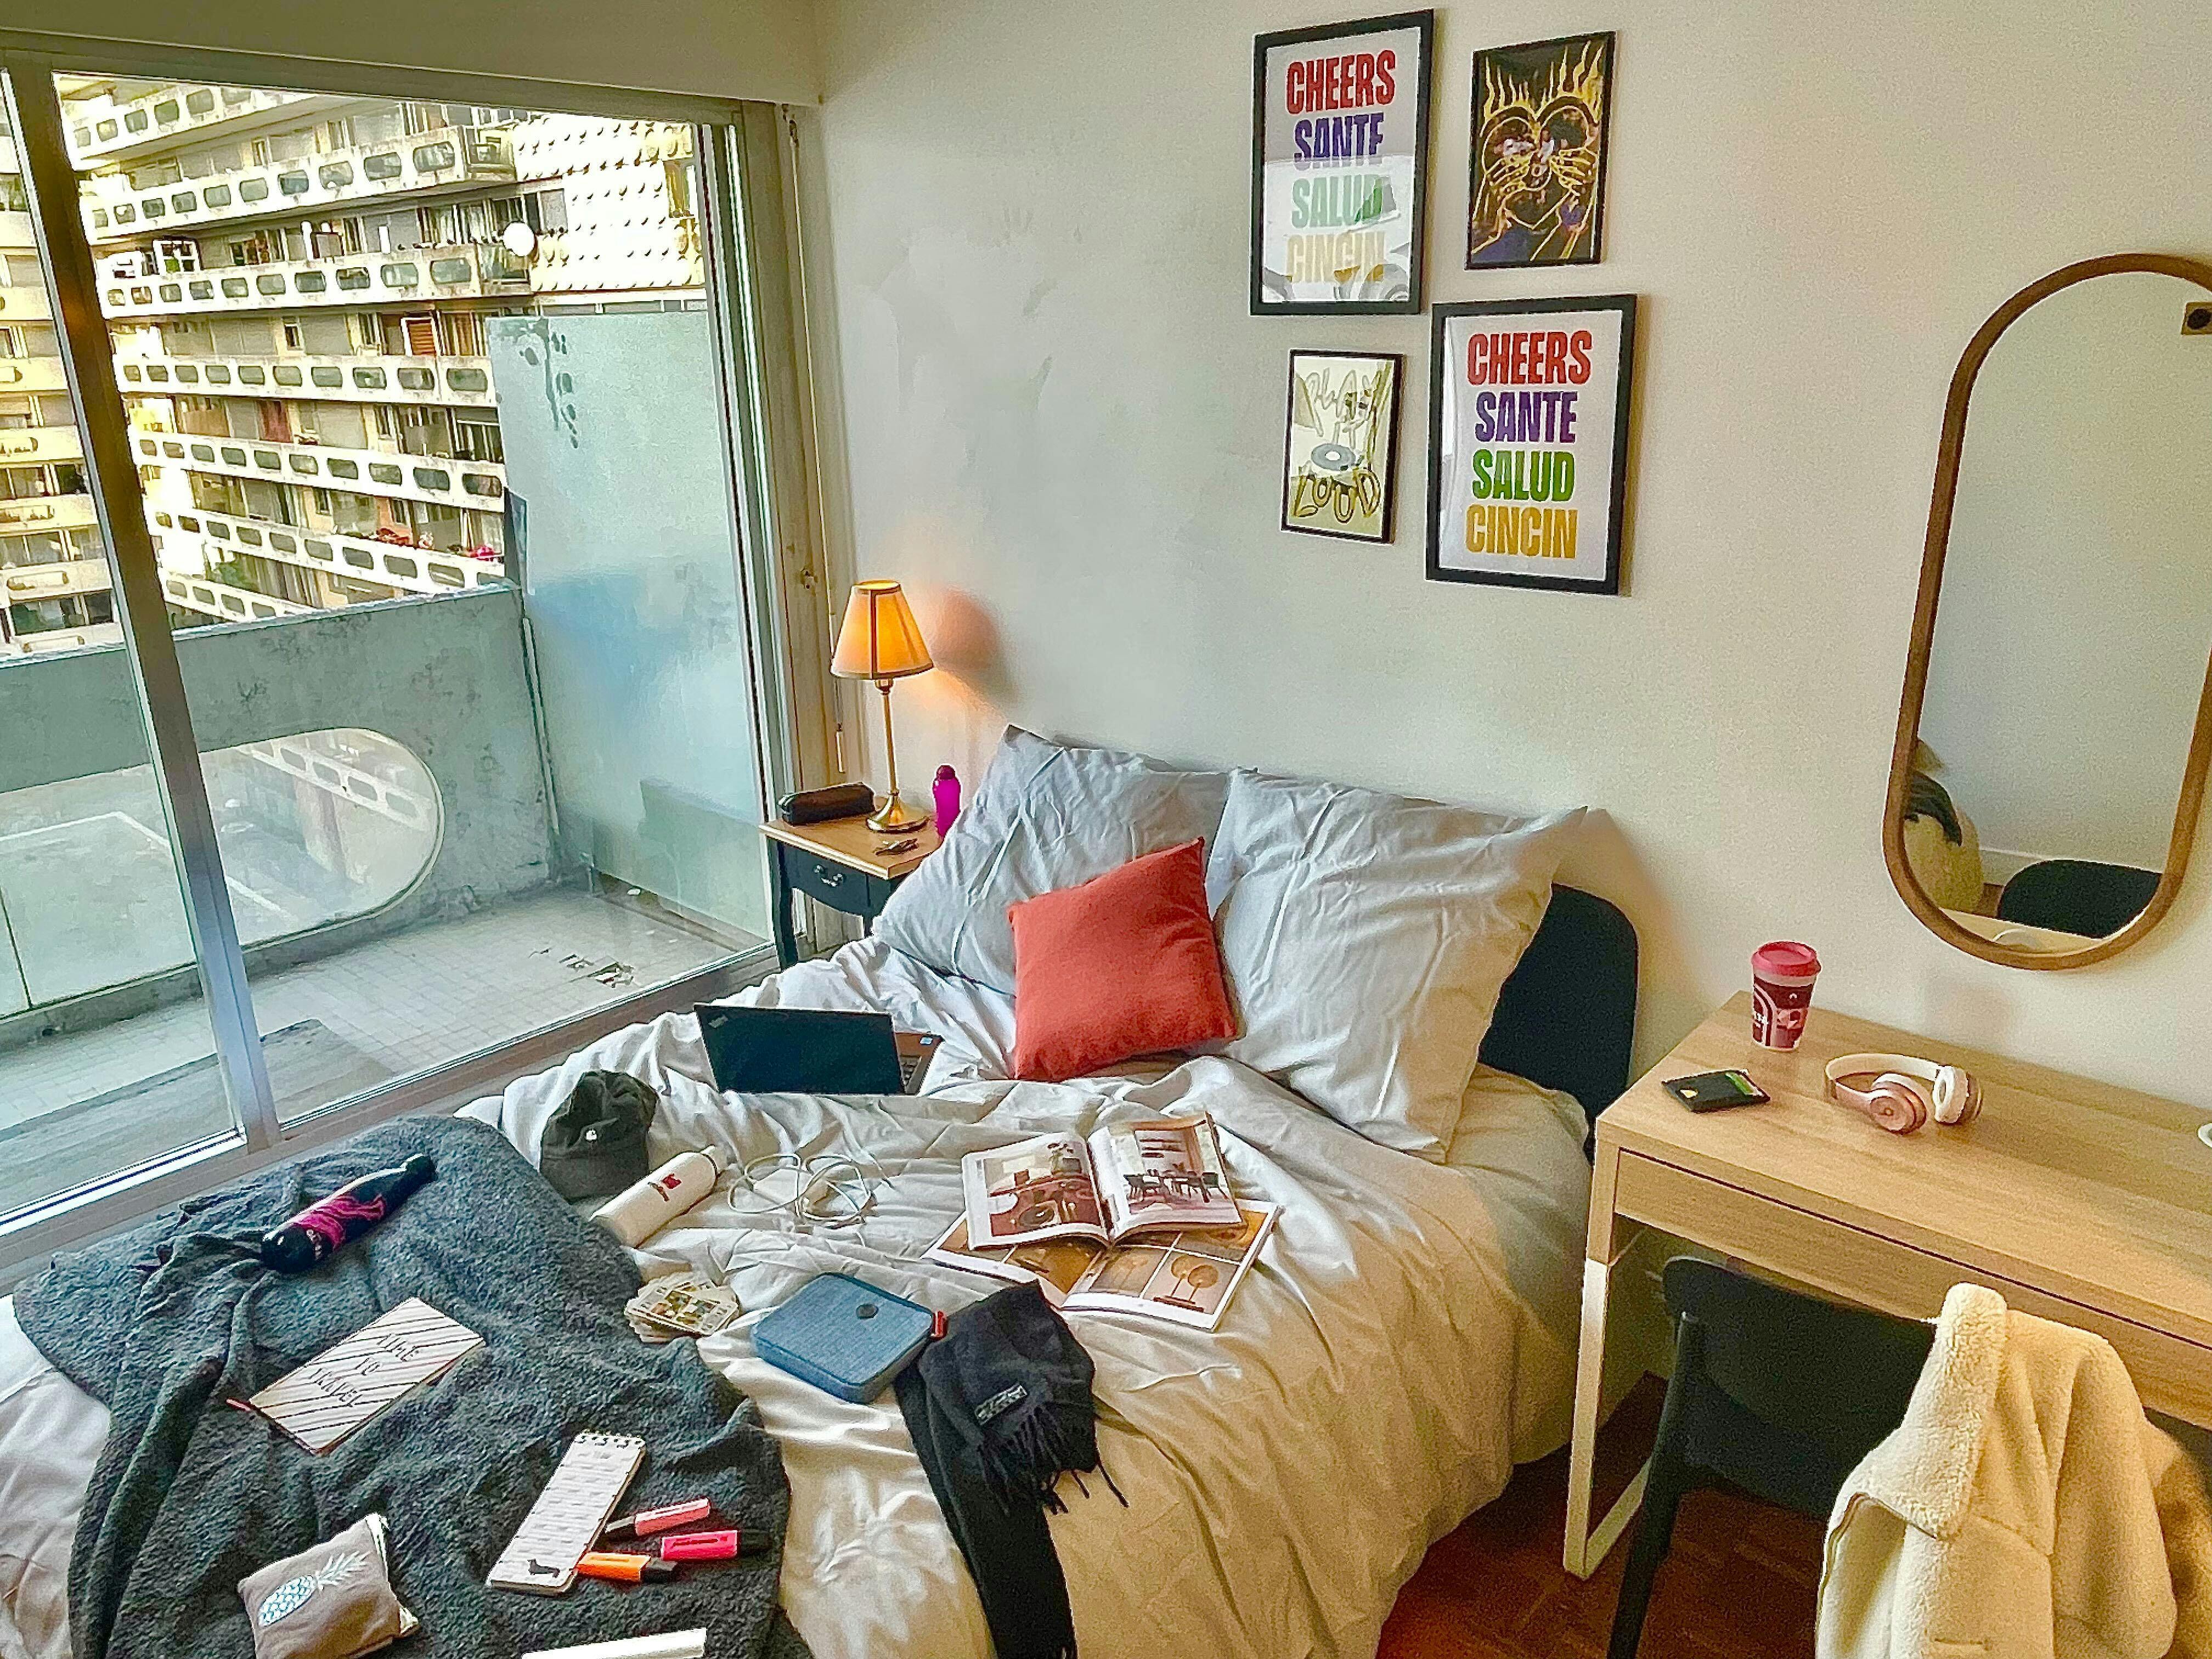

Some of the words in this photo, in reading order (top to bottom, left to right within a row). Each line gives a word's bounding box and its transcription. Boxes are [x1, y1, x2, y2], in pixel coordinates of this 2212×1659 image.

[1286, 50, 1396, 115] CHEERS
[1294, 112, 1384, 171] SANTE
[1291, 174, 1383, 228] SALUD
[1286, 232, 1385, 283] CINCIN
[1466, 330, 1593, 385] CHEERS
[1475, 391, 1578, 443] SANTE
[1291, 465, 1381, 524] LOUD
[1472, 449, 1575, 502] SALUD
[1465, 505, 1578, 559] CINCIN
